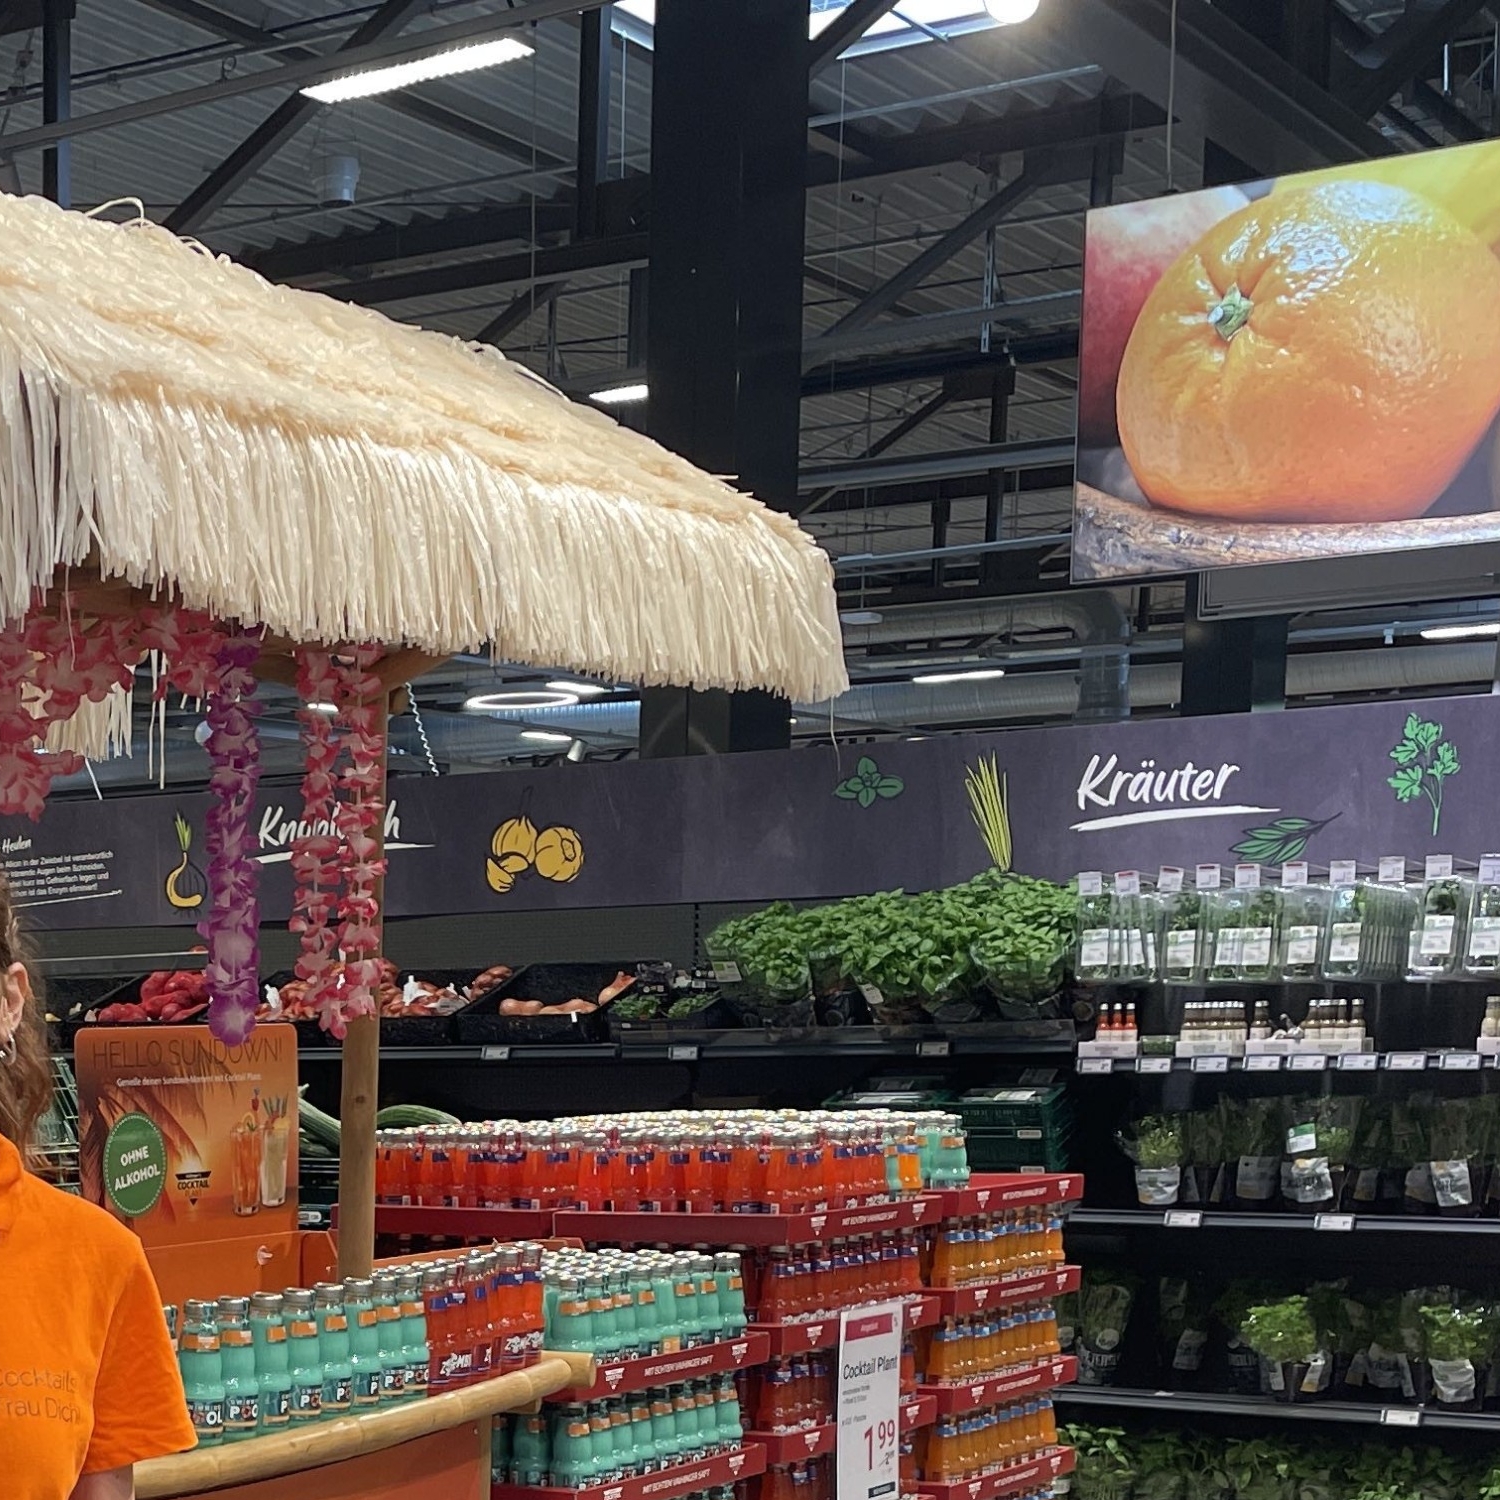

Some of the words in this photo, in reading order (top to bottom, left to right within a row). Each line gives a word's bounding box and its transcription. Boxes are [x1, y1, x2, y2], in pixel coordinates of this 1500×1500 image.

[1077, 754, 1240, 810] Kräuter
[258, 800, 400, 849] Knoblh
[93, 1040, 163, 1069] HELLO
[168, 1038, 283, 1066] SUNDOWN!
[120, 1145, 150, 1167] OHNE
[114, 1163, 161, 1191] ALKOHOL
[177, 1180, 210, 1191] COCKTAIL
[843, 1357, 876, 1380] Cocktail
[877, 1355, 898, 1374] Plant
